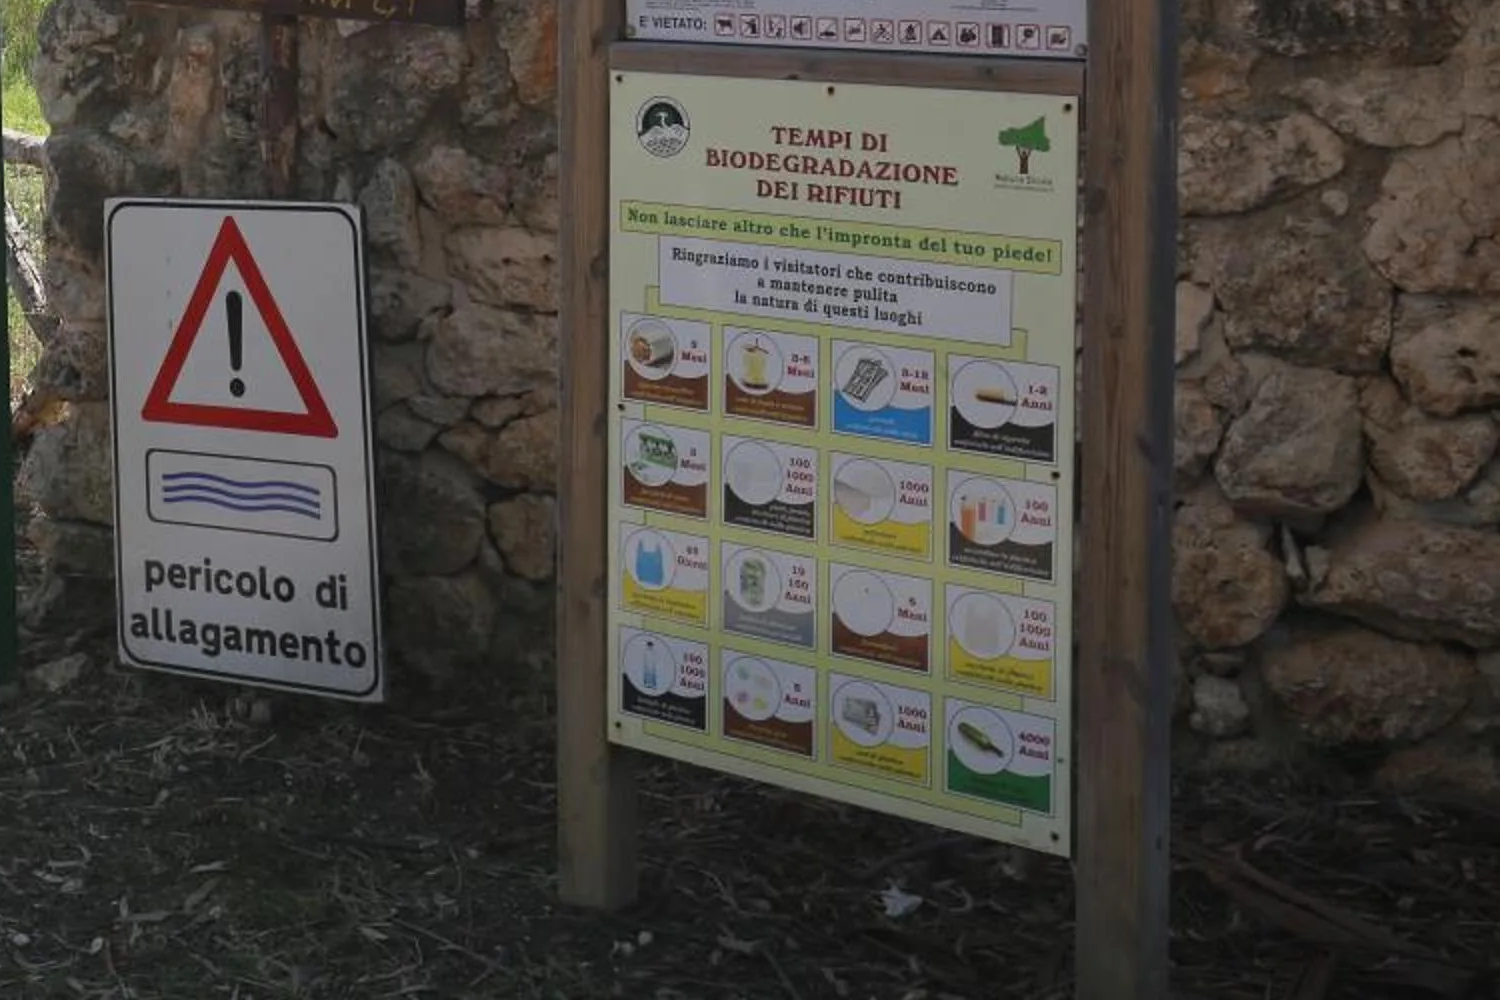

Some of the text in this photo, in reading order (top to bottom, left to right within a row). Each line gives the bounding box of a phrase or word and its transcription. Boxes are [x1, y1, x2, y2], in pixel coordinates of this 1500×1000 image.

[771, 125, 888, 152] TEMPI DI
[706, 148, 959, 186] BIODEGRADAZIONE
[756, 179, 901, 209] DEI RIFIUTI
[627, 207, 1052, 263] Non lasciare altro che l'impronta del tuo piede!
[672, 247, 759, 269] Ringraziamo
[773, 257, 841, 279] visitatori
[845, 265, 873, 282] che
[878, 273, 997, 295] contribuiscono
[757, 277, 898, 303] a mantenere pulita
[735, 290, 922, 326] la natura di questi luoghi
[900, 381, 930, 394] Mesi
[1021, 398, 1053, 411] Anni
[899, 494, 928, 507] Anni
[1020, 512, 1053, 526] Anni
[144, 557, 348, 611] pericolo di
[130, 607, 367, 669] allagamento
[1019, 638, 1049, 652] Anni
[897, 720, 927, 734] Anni
[1018, 746, 1050, 761] Anni
